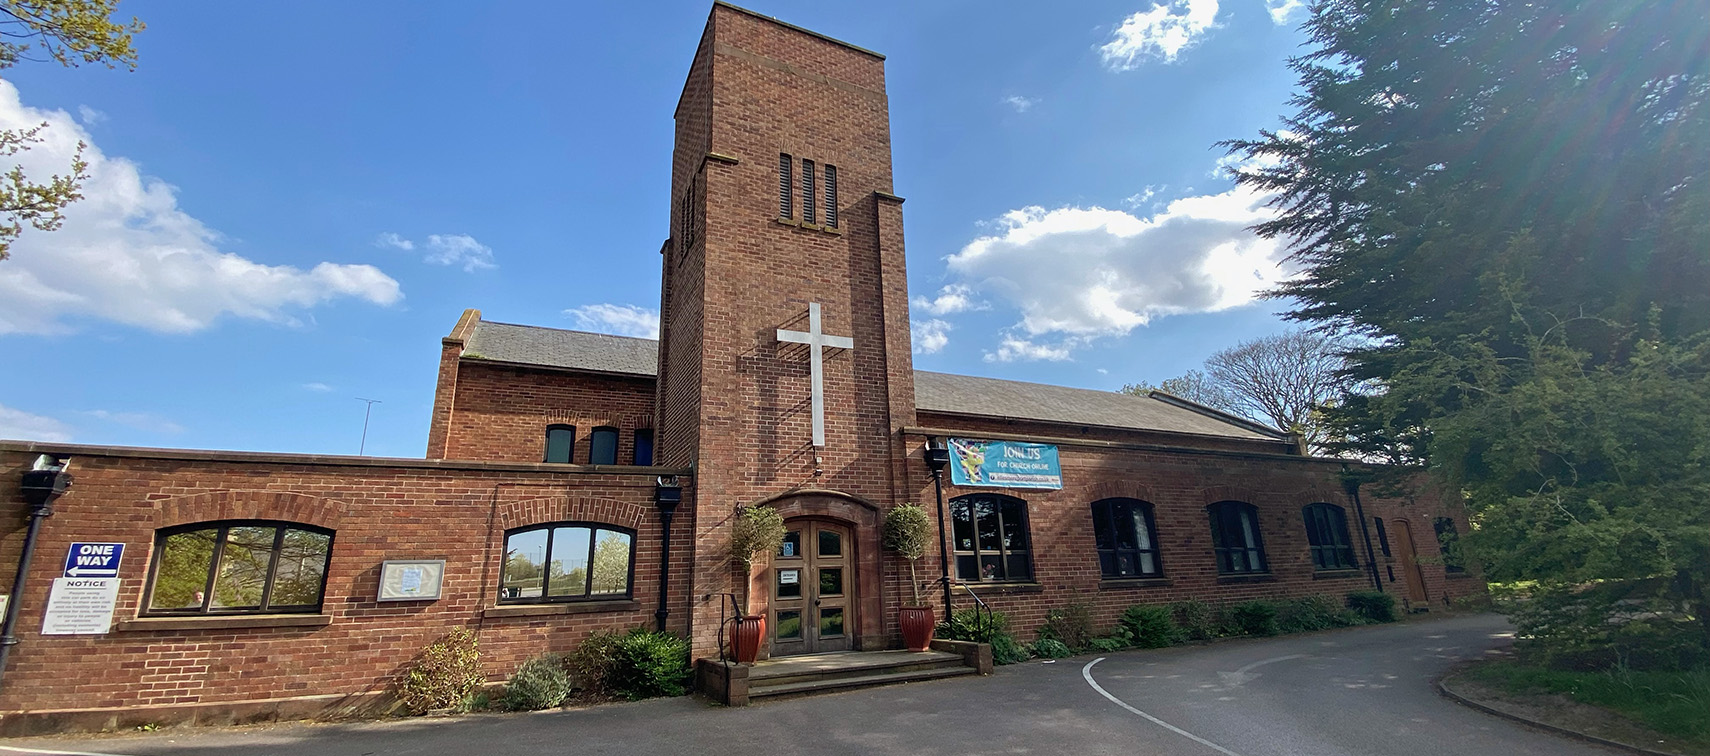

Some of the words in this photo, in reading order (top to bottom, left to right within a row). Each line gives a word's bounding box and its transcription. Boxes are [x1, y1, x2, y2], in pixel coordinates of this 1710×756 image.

[1004, 445, 1024, 459] JOIN
[1027, 447, 1041, 460] US
[80, 545, 114, 555] ONE
[77, 556, 112, 565] WAY
